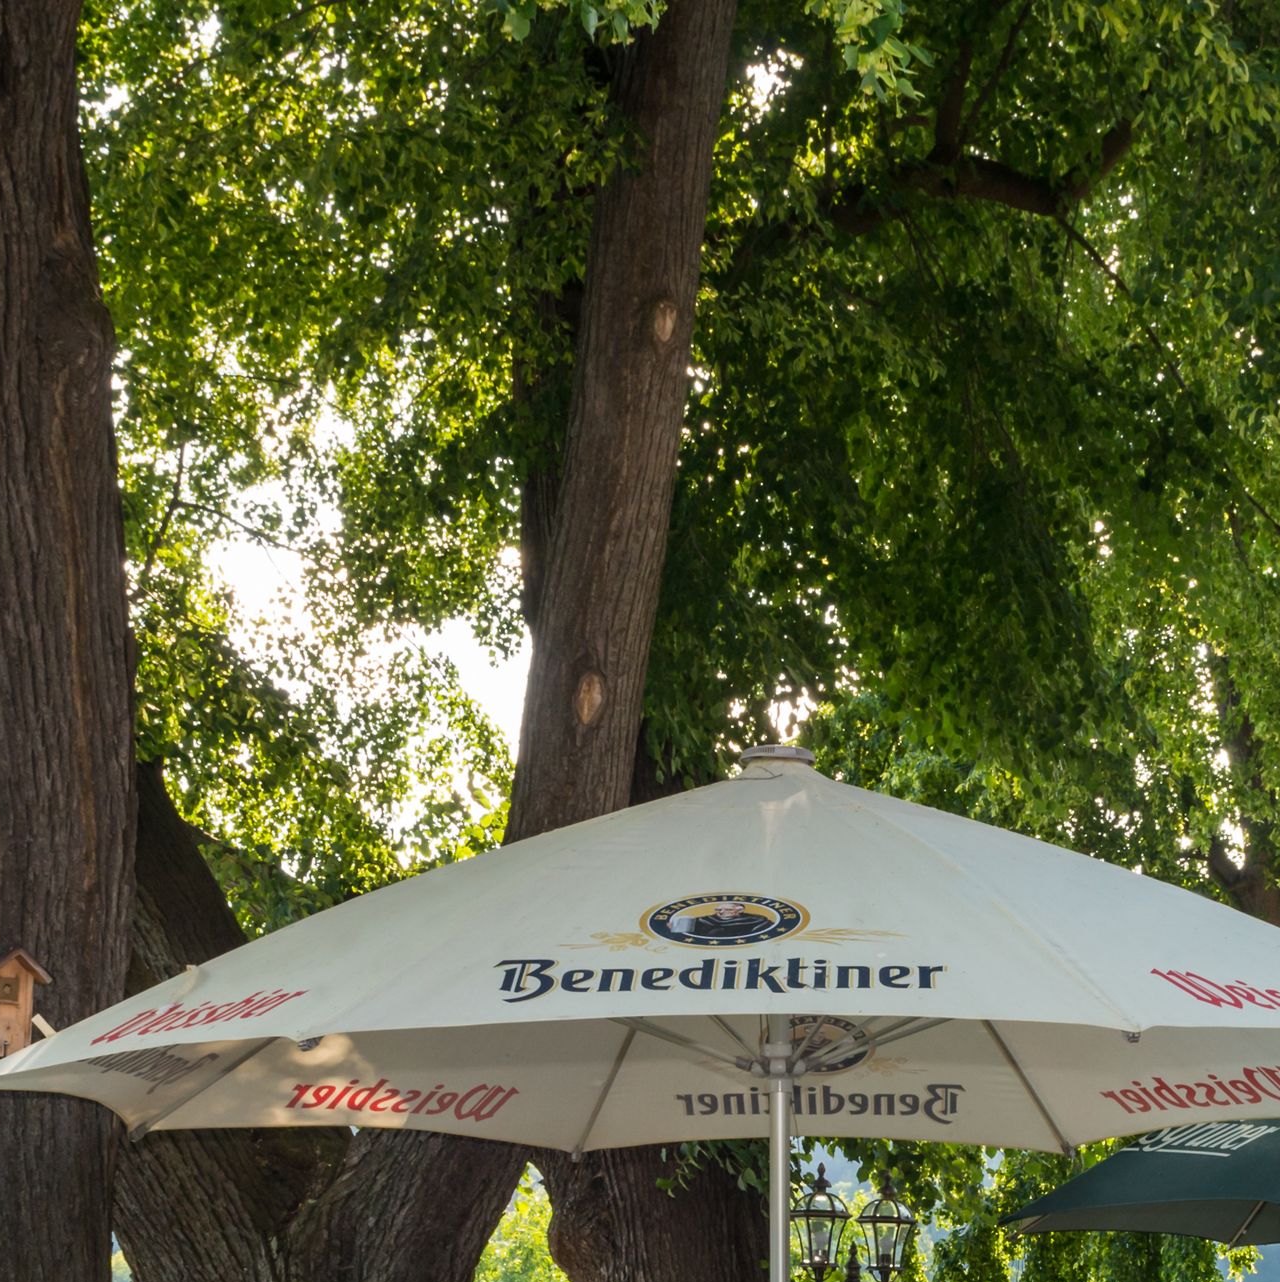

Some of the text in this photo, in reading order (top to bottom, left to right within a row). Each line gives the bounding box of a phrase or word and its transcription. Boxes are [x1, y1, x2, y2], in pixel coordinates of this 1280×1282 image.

[654, 893, 797, 921] BENEDIKTINER
[494, 958, 948, 1003] Benediktiner
[90, 988, 310, 1046] Weissbier
